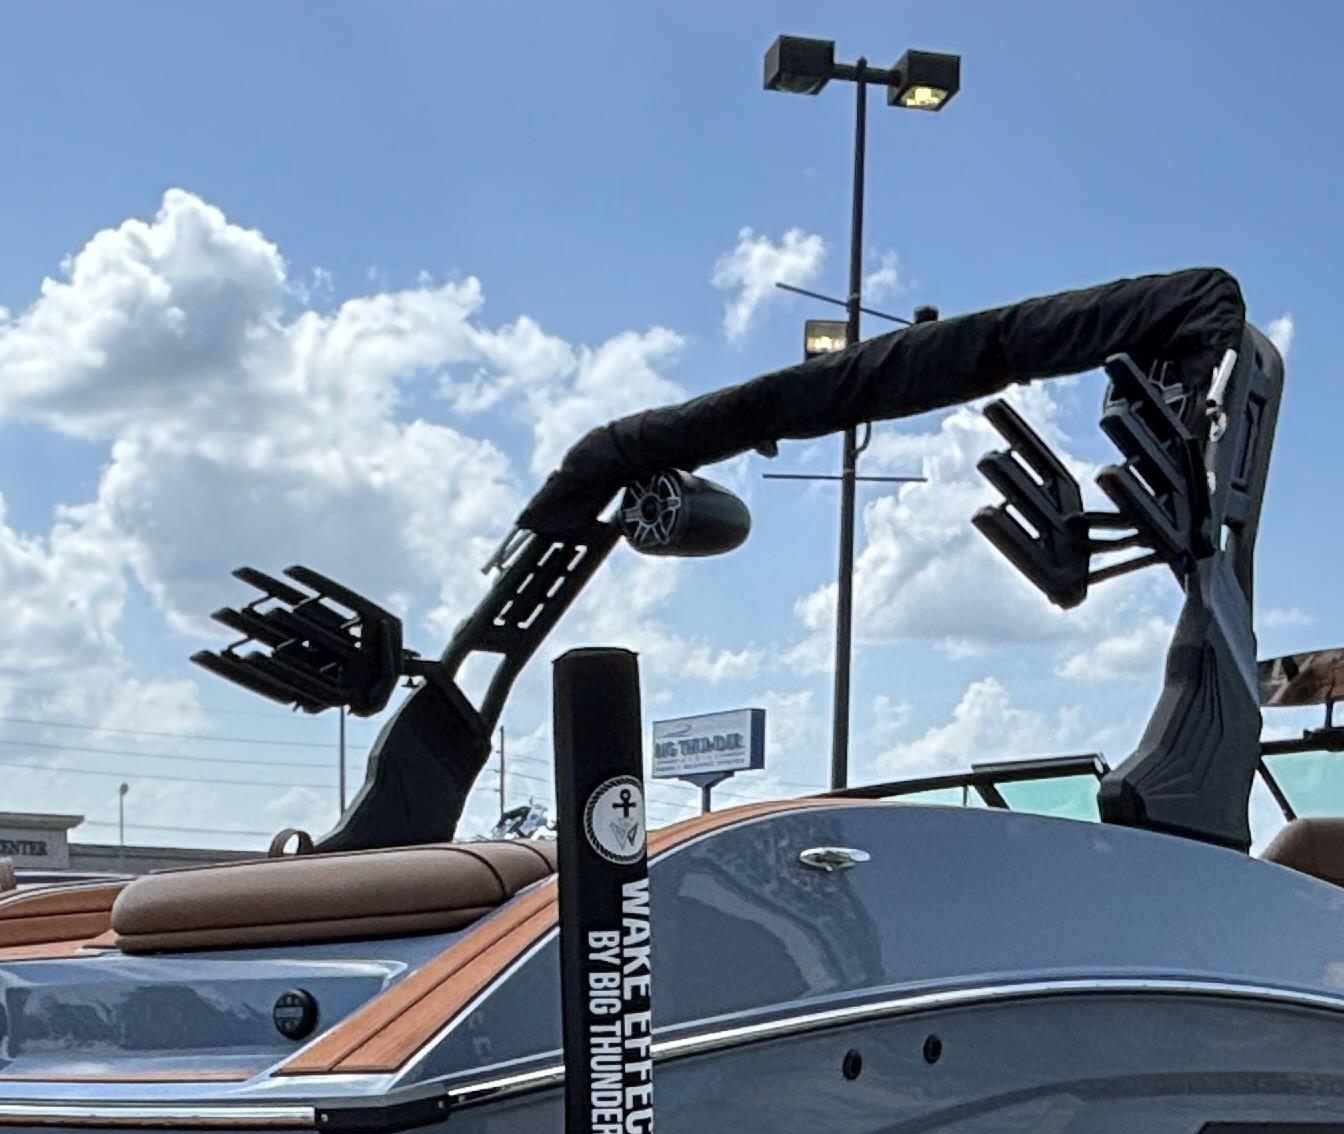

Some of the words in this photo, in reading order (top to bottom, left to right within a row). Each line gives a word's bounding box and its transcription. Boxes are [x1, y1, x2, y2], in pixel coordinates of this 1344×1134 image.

[589, 930, 621, 965] BY
[622, 876, 651, 1000] WAKE
[590, 972, 622, 1015] BIG
